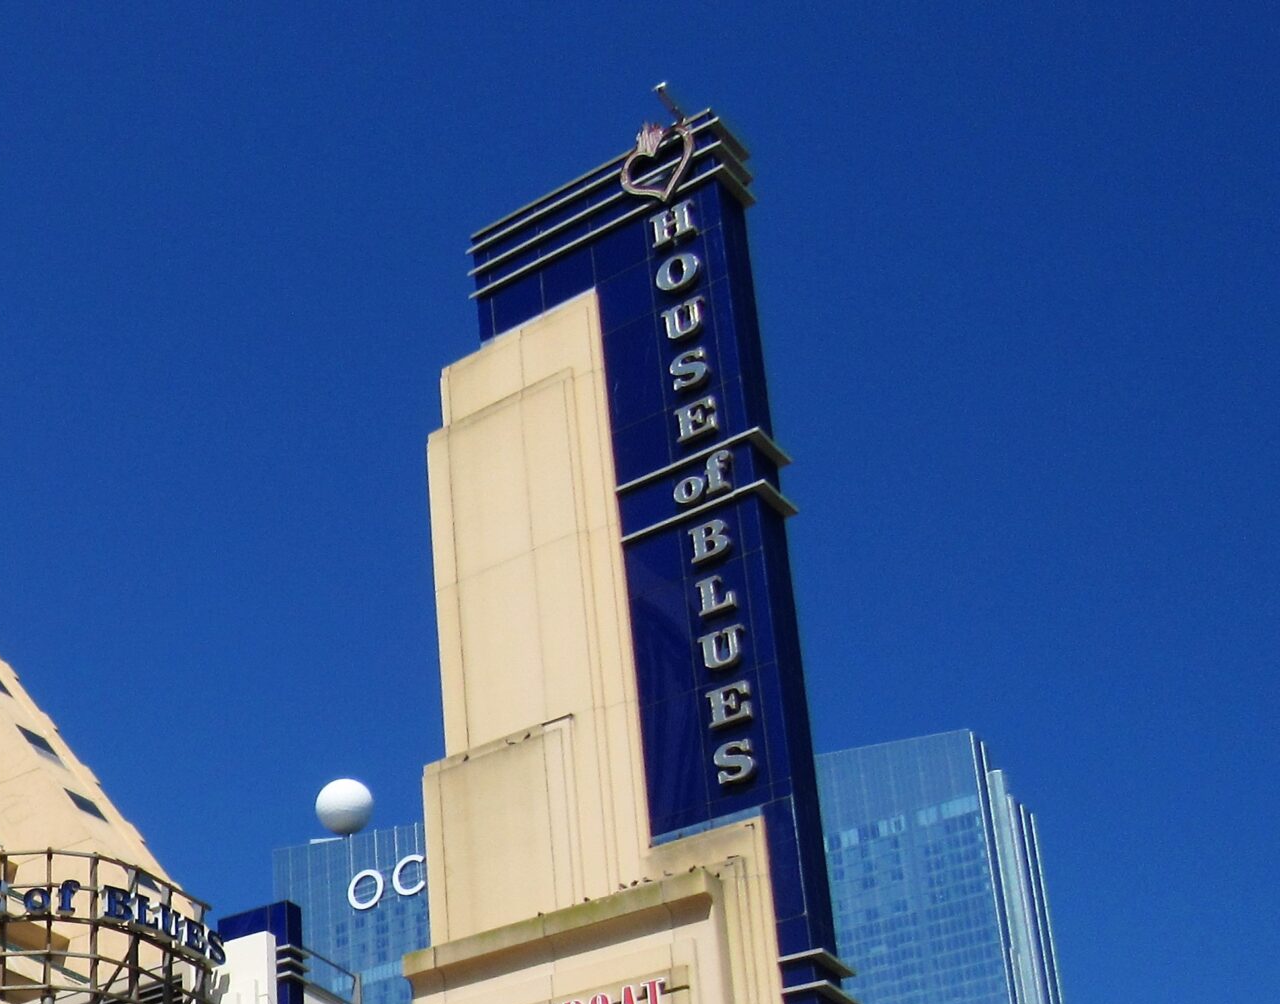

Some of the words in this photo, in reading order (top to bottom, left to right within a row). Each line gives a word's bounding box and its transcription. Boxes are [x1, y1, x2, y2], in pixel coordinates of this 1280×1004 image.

[650, 201, 719, 443] HOUSE
[673, 450, 732, 505] of
[688, 518, 757, 787] BLUES
[24, 880, 80, 916] of
[102, 885, 227, 968] BLUES
